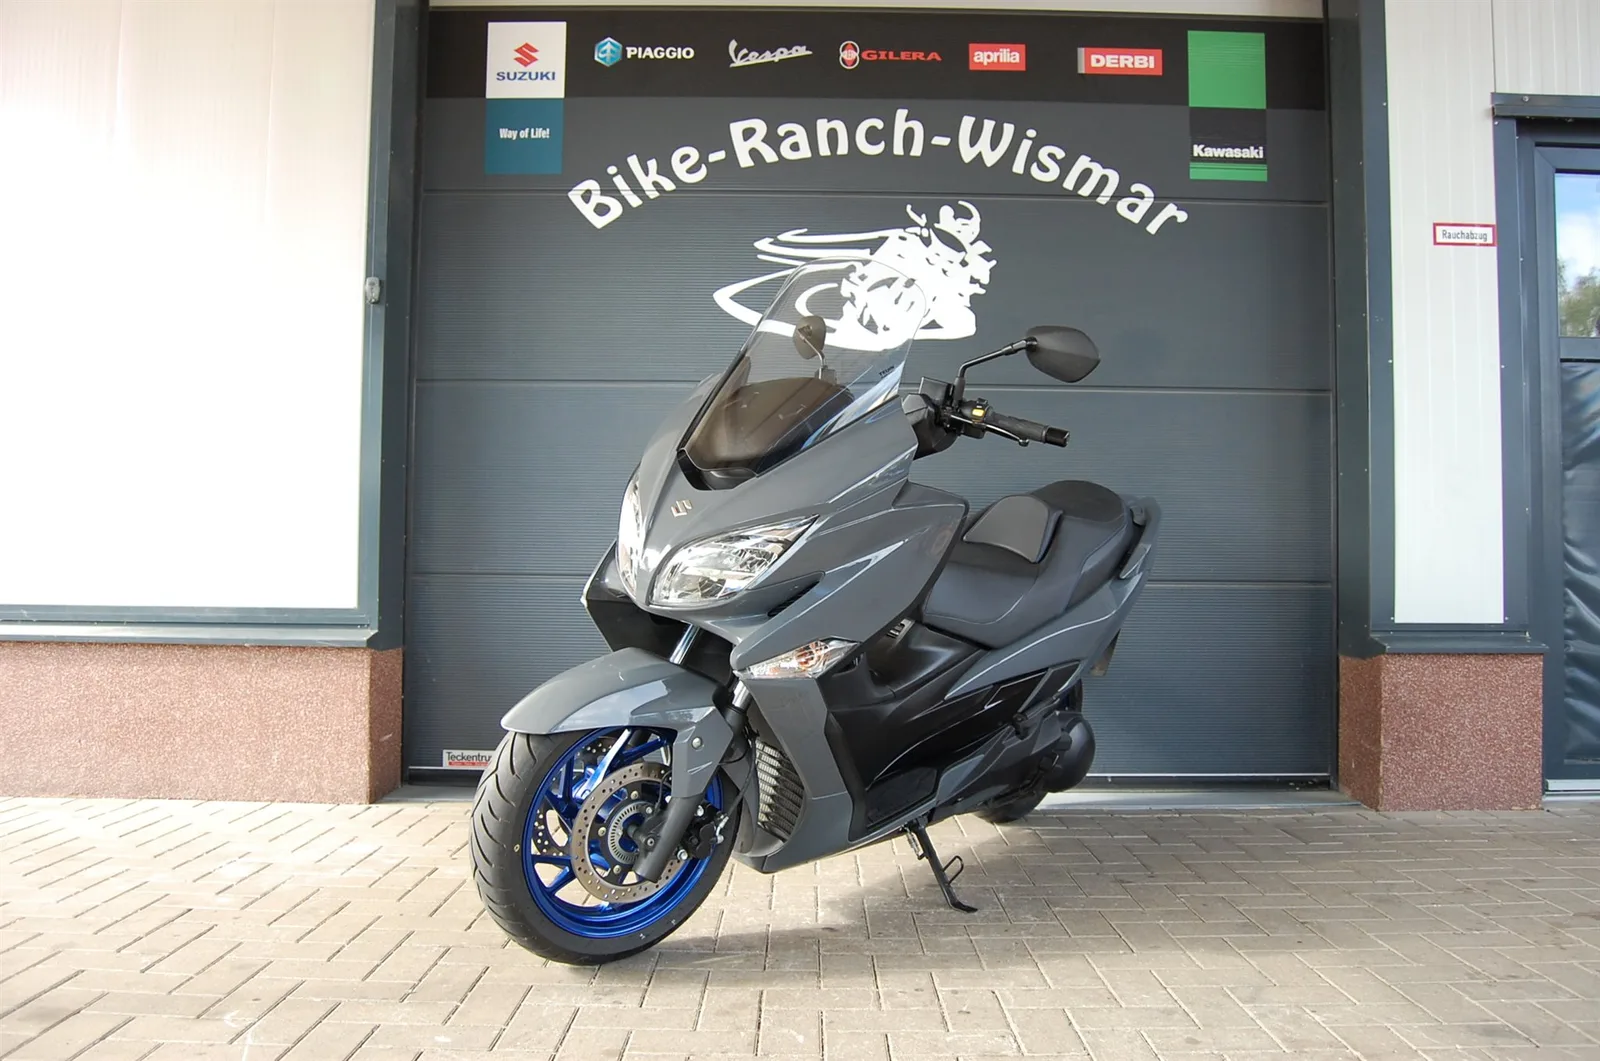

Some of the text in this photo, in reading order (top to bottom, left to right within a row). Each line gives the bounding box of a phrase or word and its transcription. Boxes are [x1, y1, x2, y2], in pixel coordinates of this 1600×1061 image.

[625, 46, 695, 60] PIAGGIO
[728, 39, 813, 68] Vespa
[861, 50, 942, 61] GILERA
[973, 48, 1020, 66] aprilia
[1090, 54, 1155, 69] DERBI
[496, 71, 556, 81] SUZUKI
[499, 128, 550, 140] Way of Life!
[1193, 144, 1264, 159] Kawasaki
[1442, 229, 1488, 242] Rauchabzug
